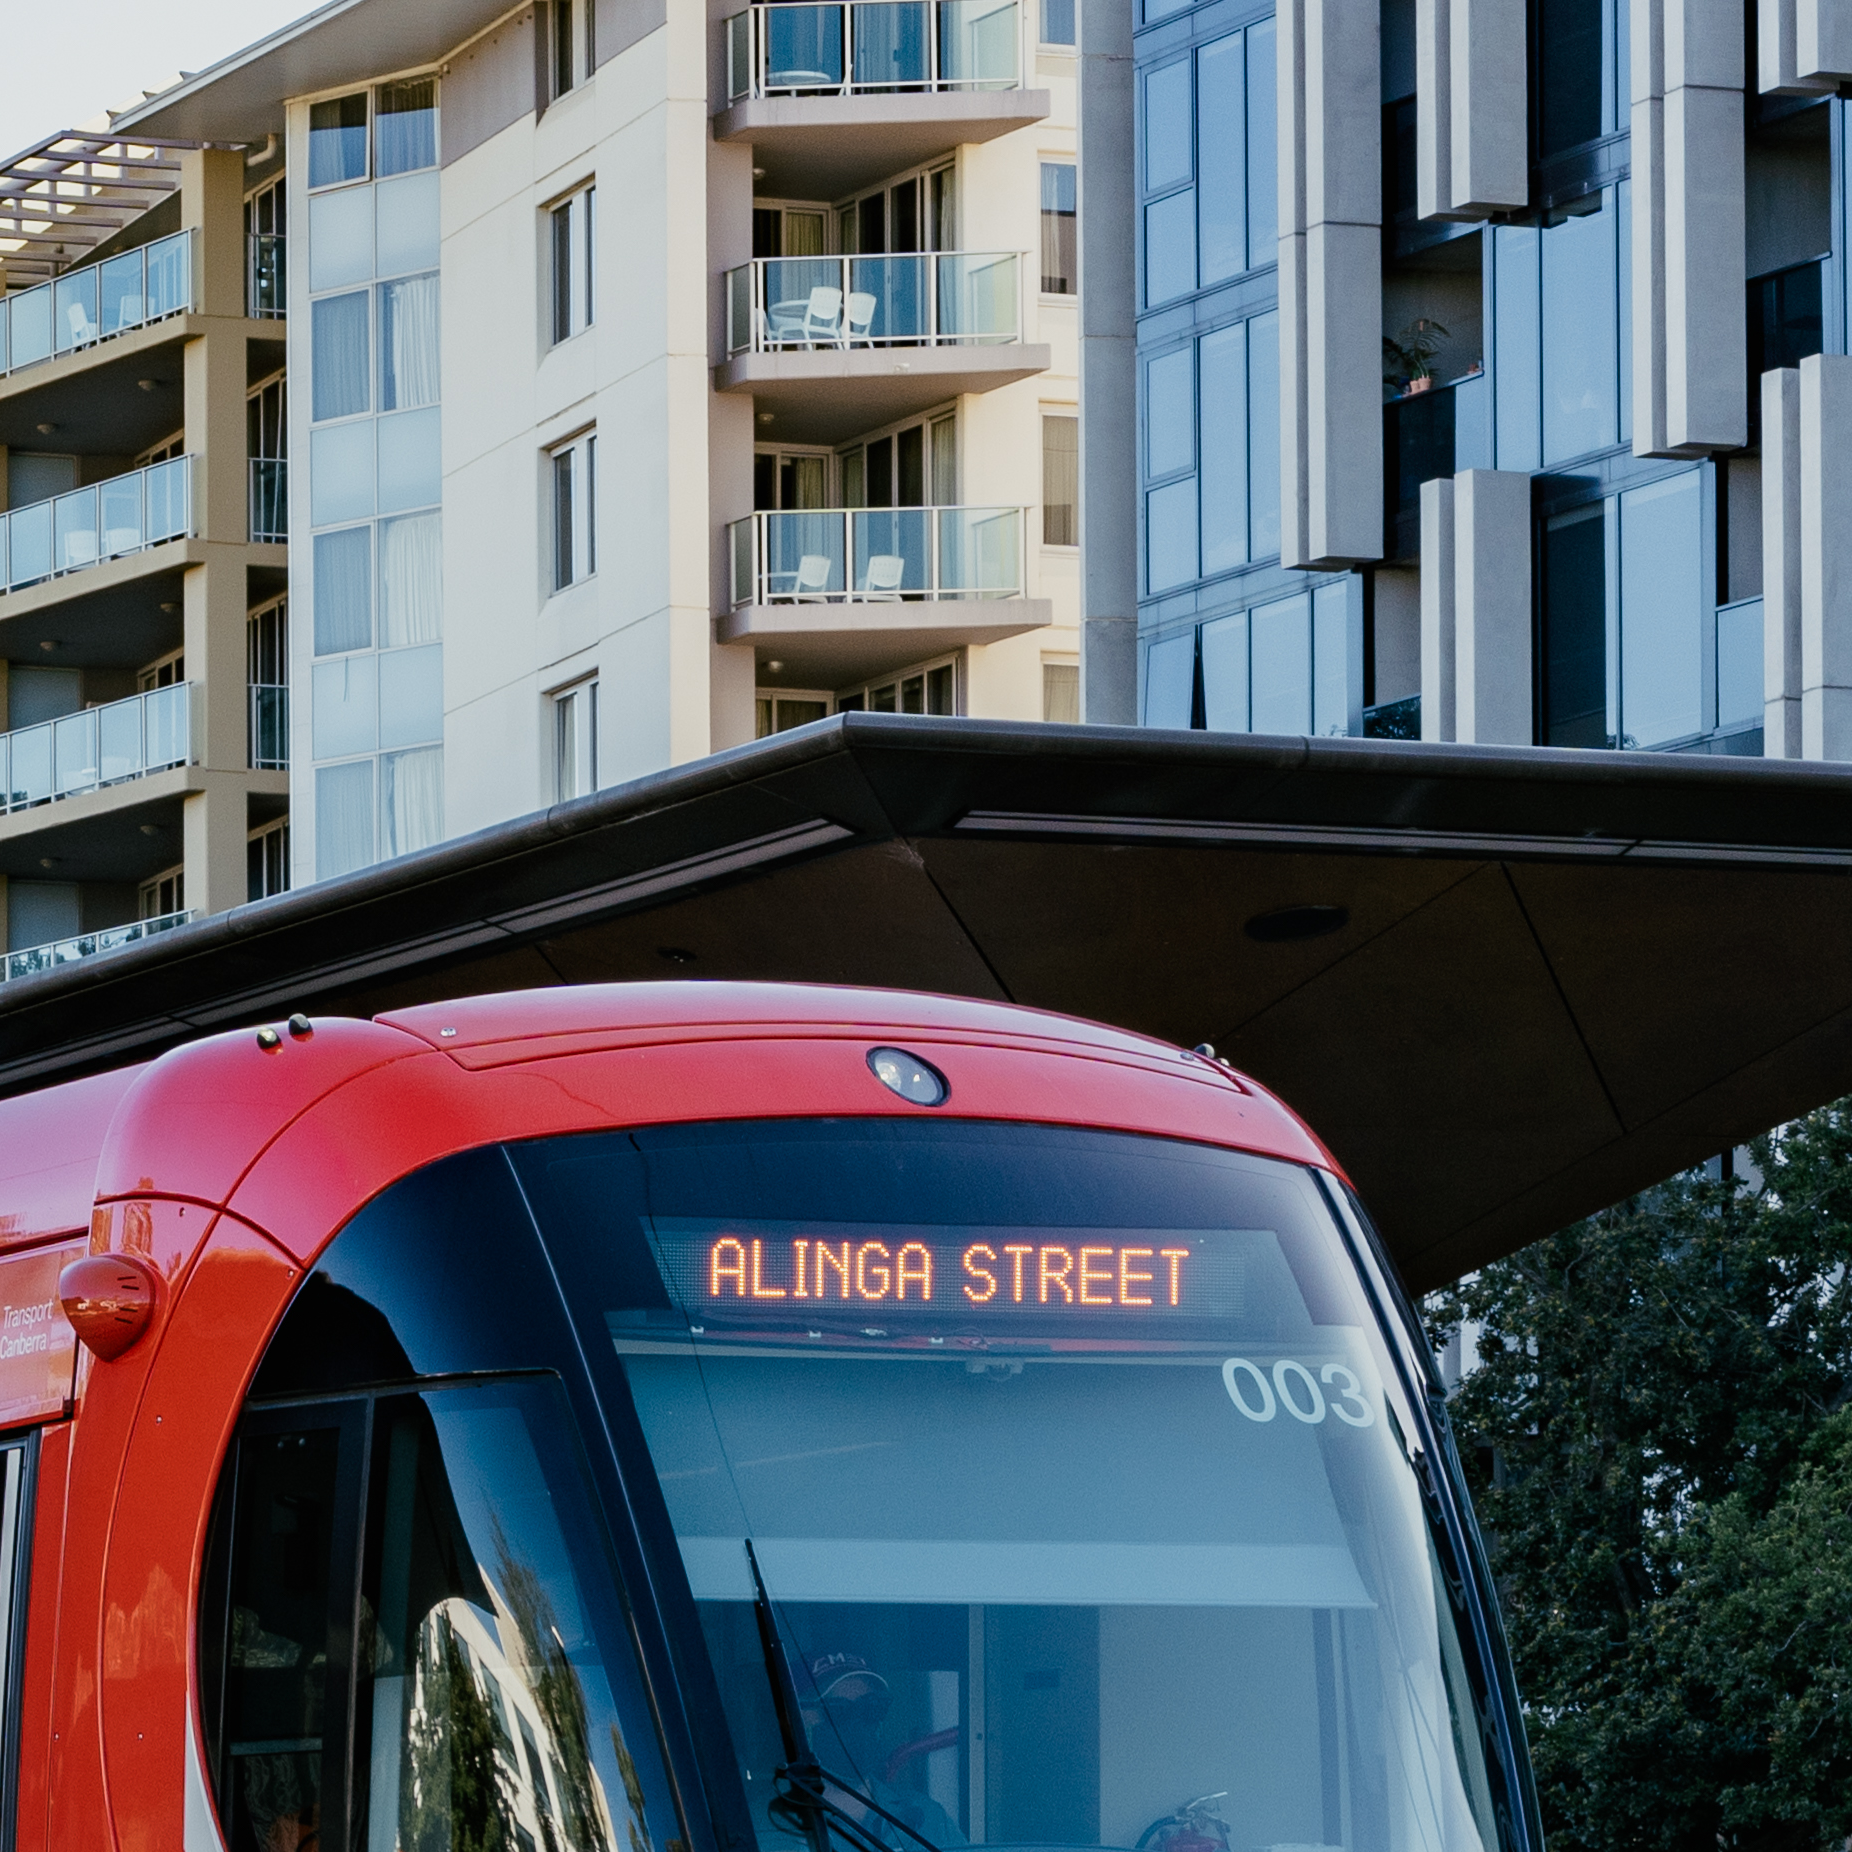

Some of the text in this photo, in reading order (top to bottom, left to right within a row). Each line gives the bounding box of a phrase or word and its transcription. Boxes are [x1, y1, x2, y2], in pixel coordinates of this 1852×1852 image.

[709, 1237, 1190, 1307] ALINGA STREET
[3, 1298, 54, 1331] Transport
[0, 1332, 47, 1360] Canberra
[1221, 1357, 1377, 1429] 003
